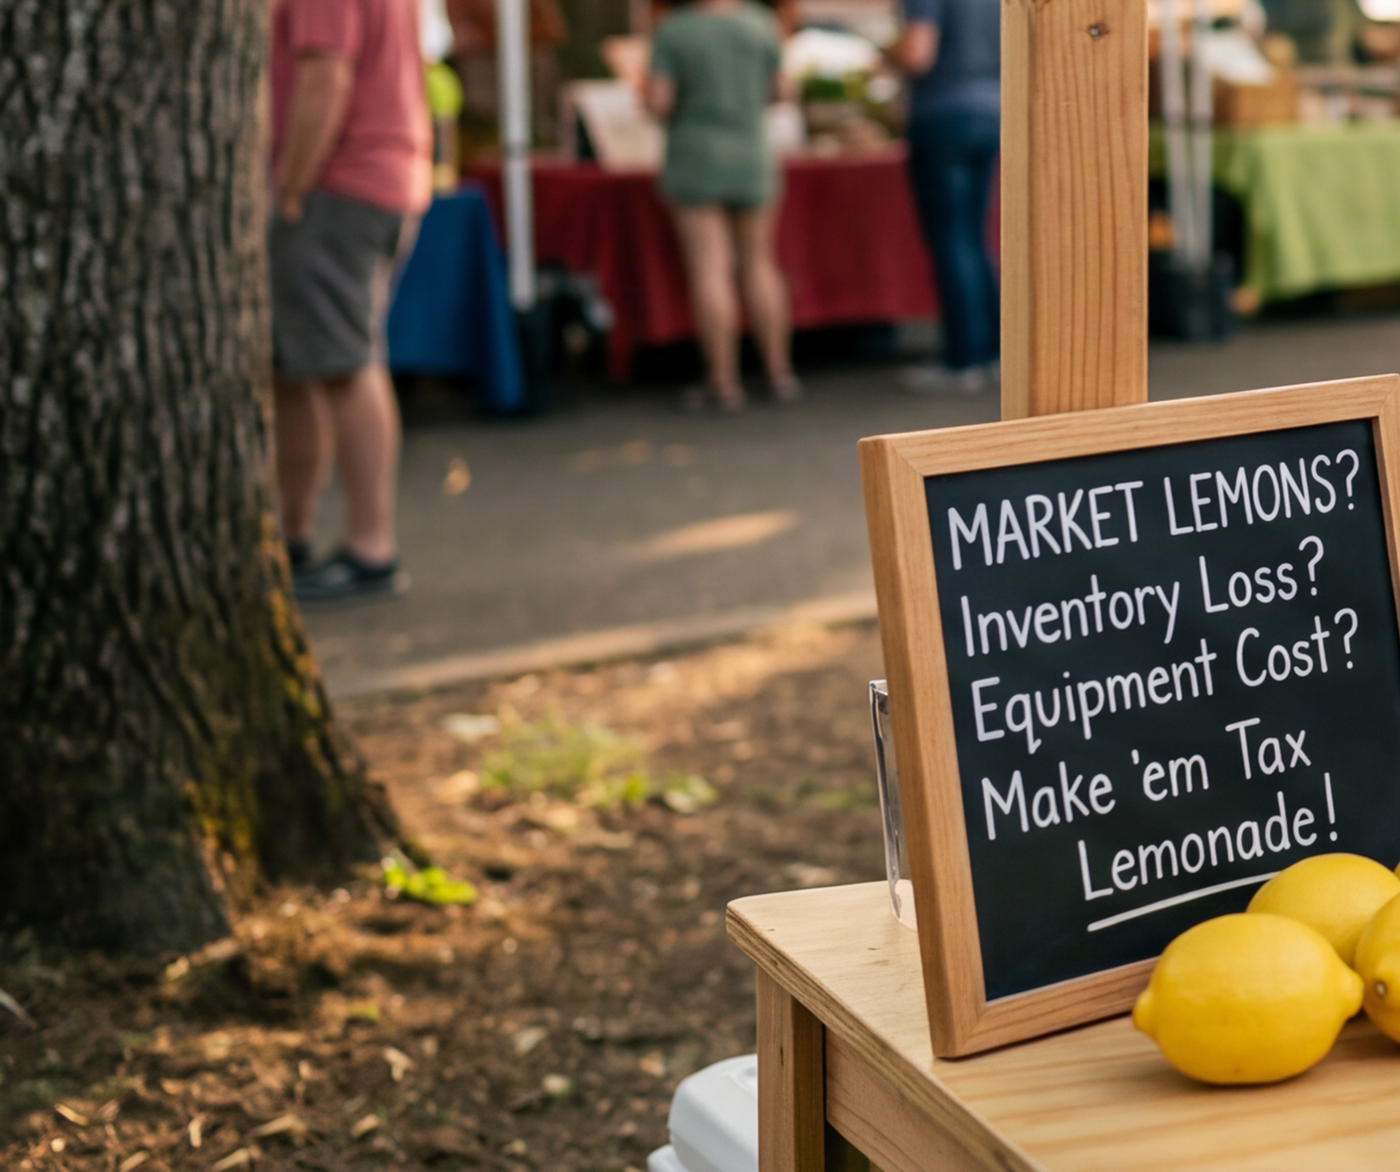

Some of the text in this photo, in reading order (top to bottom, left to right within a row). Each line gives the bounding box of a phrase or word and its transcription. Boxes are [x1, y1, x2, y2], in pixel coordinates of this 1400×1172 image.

[947, 448, 1360, 571] MARKET LEMONS?
[960, 535, 1324, 657] Inventory Loss?
[971, 607, 1358, 755] Equipment Cost?
[981, 761, 1116, 841] Make
[1225, 717, 1312, 780] Tax
[1077, 772, 1338, 901] Lemonade!
